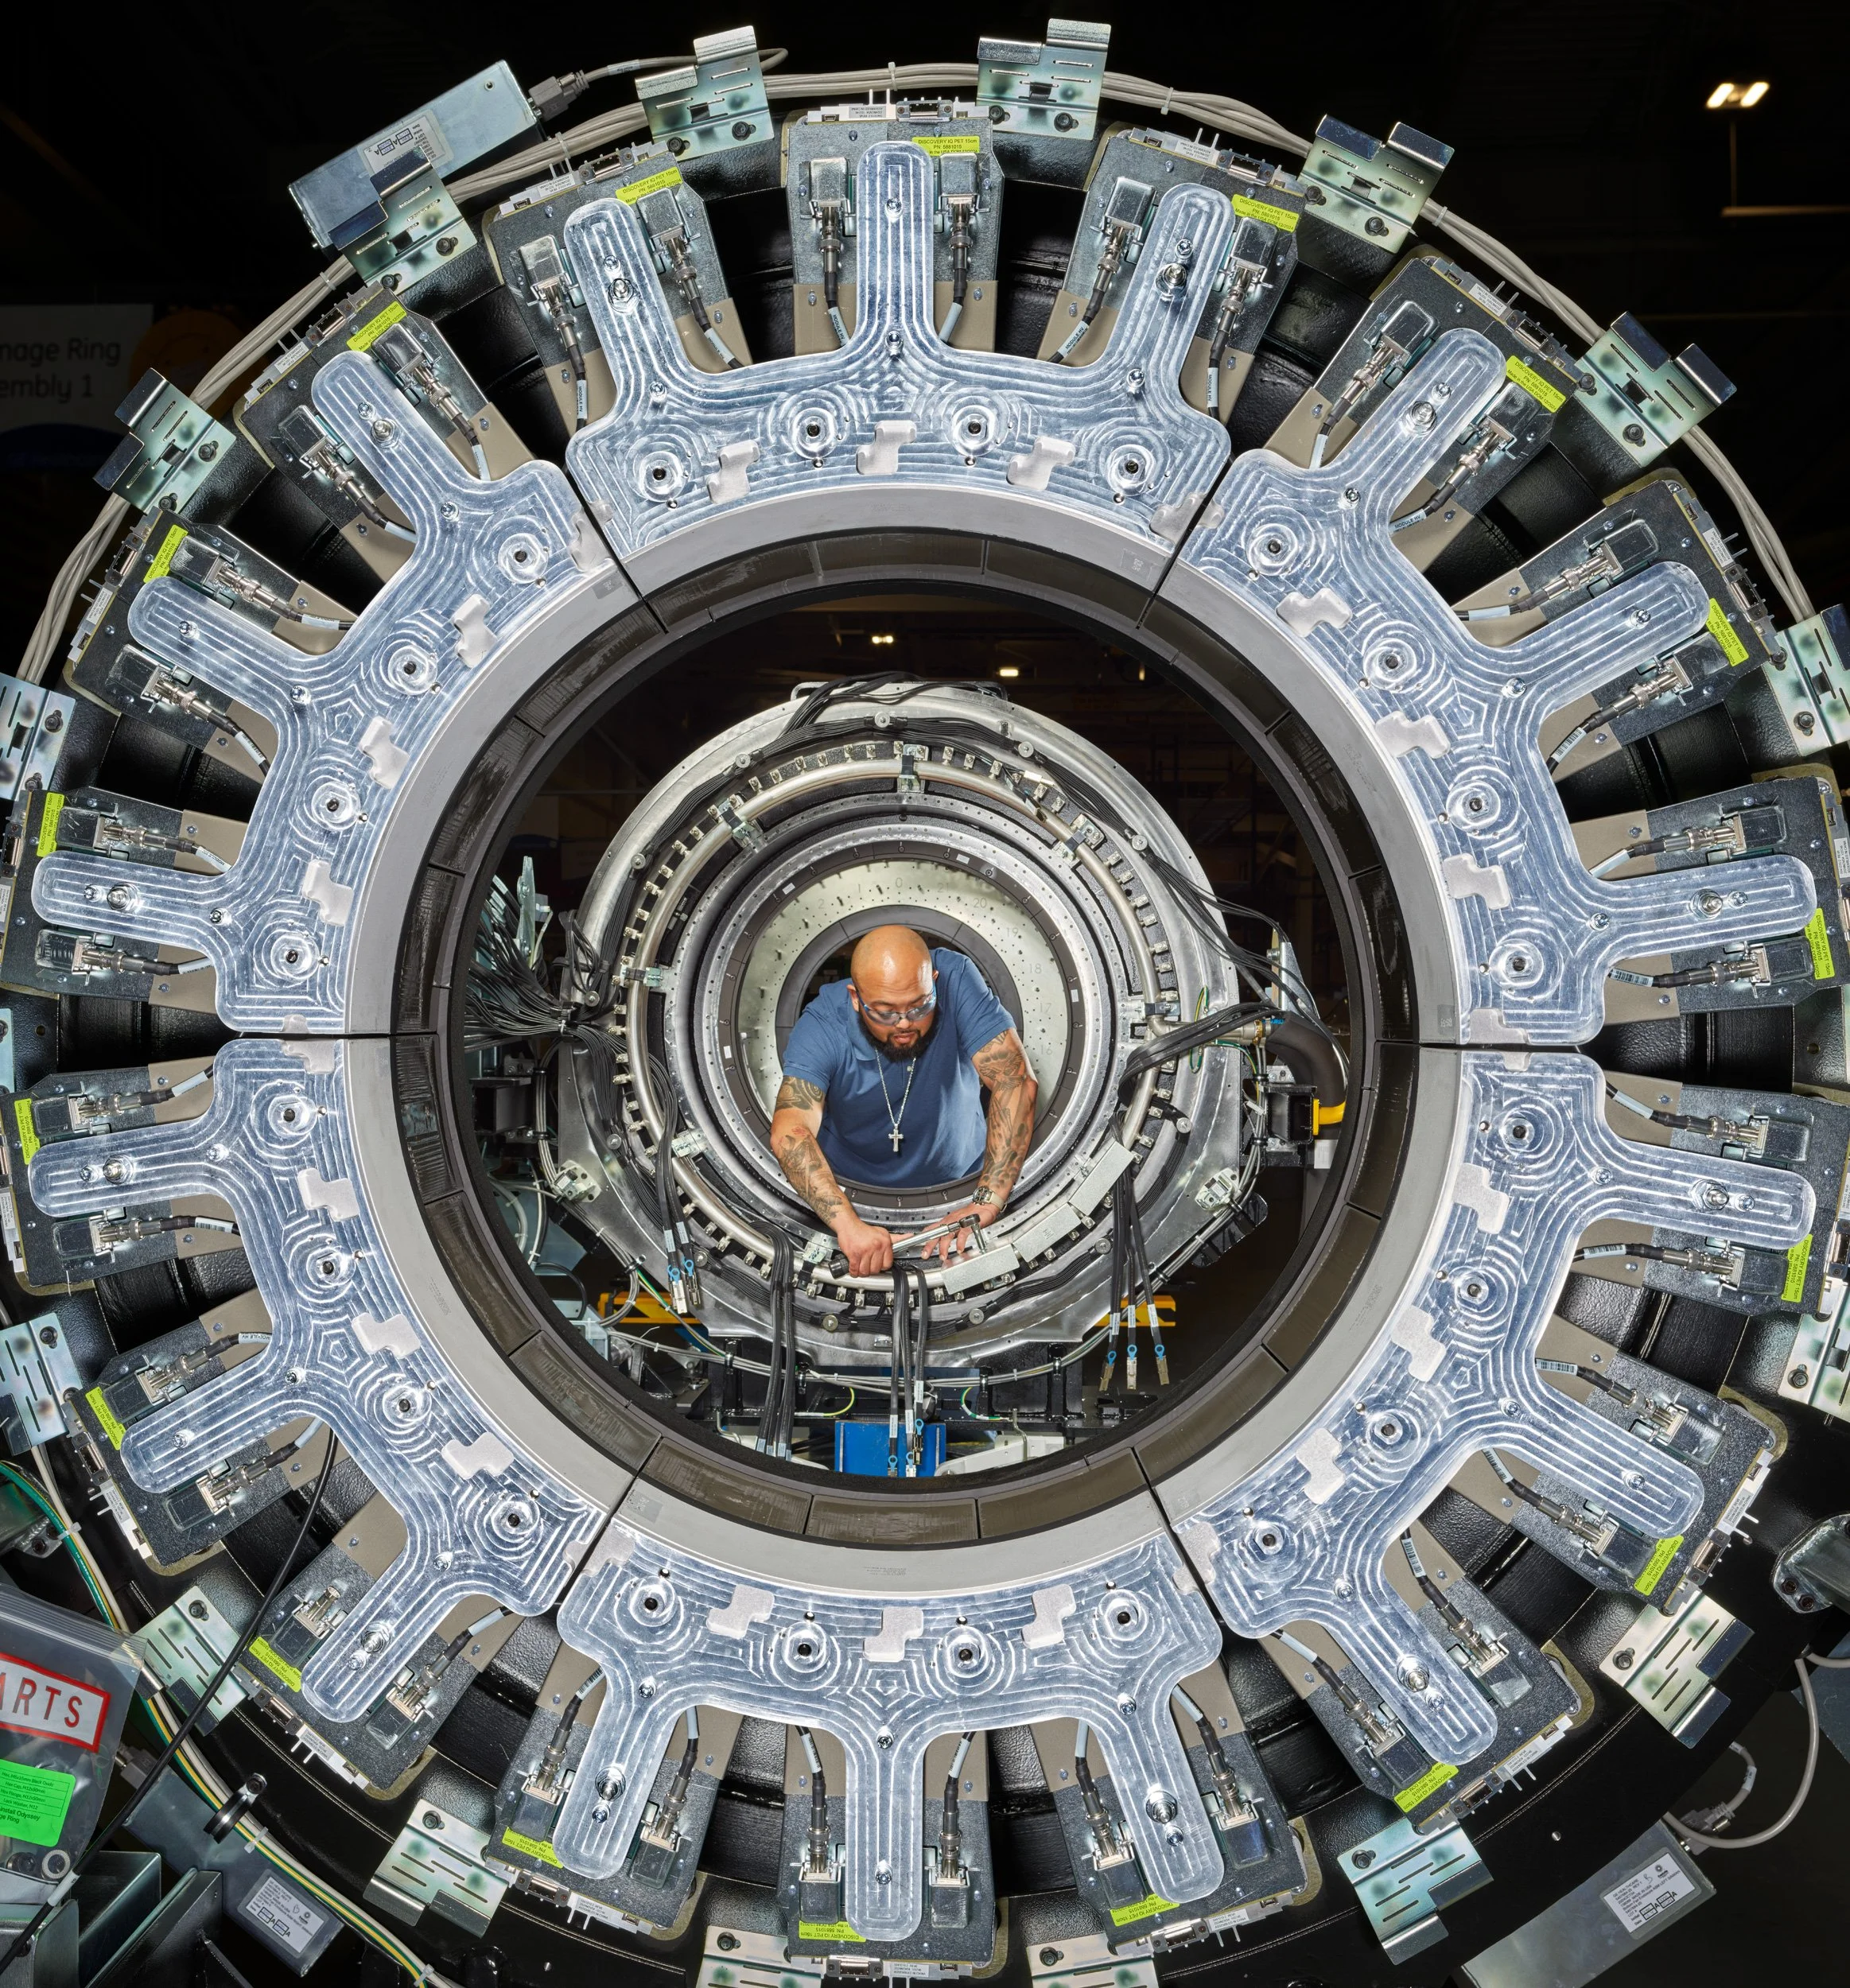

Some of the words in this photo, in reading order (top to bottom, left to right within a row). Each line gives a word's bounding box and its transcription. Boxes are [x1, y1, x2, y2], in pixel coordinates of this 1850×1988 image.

[622, 179, 650, 194] DISCOVERY
[1239, 197, 1268, 211] DISCOVERY
[1284, 212, 1296, 221] 15cm
[352, 321, 376, 343] DISCOVERY
[379, 311, 389, 320] PET
[387, 302, 399, 313] 15cm
[832, 314, 842, 332] MODULE
[1064, 332, 1079, 349] MODULE
[67, 337, 121, 367] Ring
[81, 373, 93, 398] 1
[1514, 361, 1540, 382] DISCOVERY
[1542, 384, 1553, 394] PET
[1551, 391, 1564, 402] 15cm
[1525, 384, 1534, 393] USA
[1394, 517, 1413, 529] MODULE
[1711, 604, 1729, 632] DISCOVERY
[1729, 636, 1738, 646] PET
[1735, 646, 1745, 658] 15cm
[974, 898, 987, 909] 20
[1005, 926, 1019, 938] 19
[1815, 914, 1825, 945] DISCOVERY
[1028, 963, 1042, 974] 18
[1798, 1239, 1809, 1269] DISCOVERY
[87, 1392, 97, 1405] 15cm
[102, 1418, 119, 1444] DISCOVERY
[1659, 1540, 1678, 1567] DISCOVERY
[1650, 1570, 1659, 1580] PET
[1642, 1579, 1653, 1592] 15cm
[0, 1672, 83, 1728] RTS
[1426, 1770, 1452, 1792] DISCOVERY
[1413, 1792, 1424, 1802] PET
[1402, 1800, 1414, 1811] 15cm
[7, 1815, 20, 1824] Ring
[17, 1810, 41, 1821] Odyssey
[1617, 1878, 1638, 1893] HEALTHCARE
